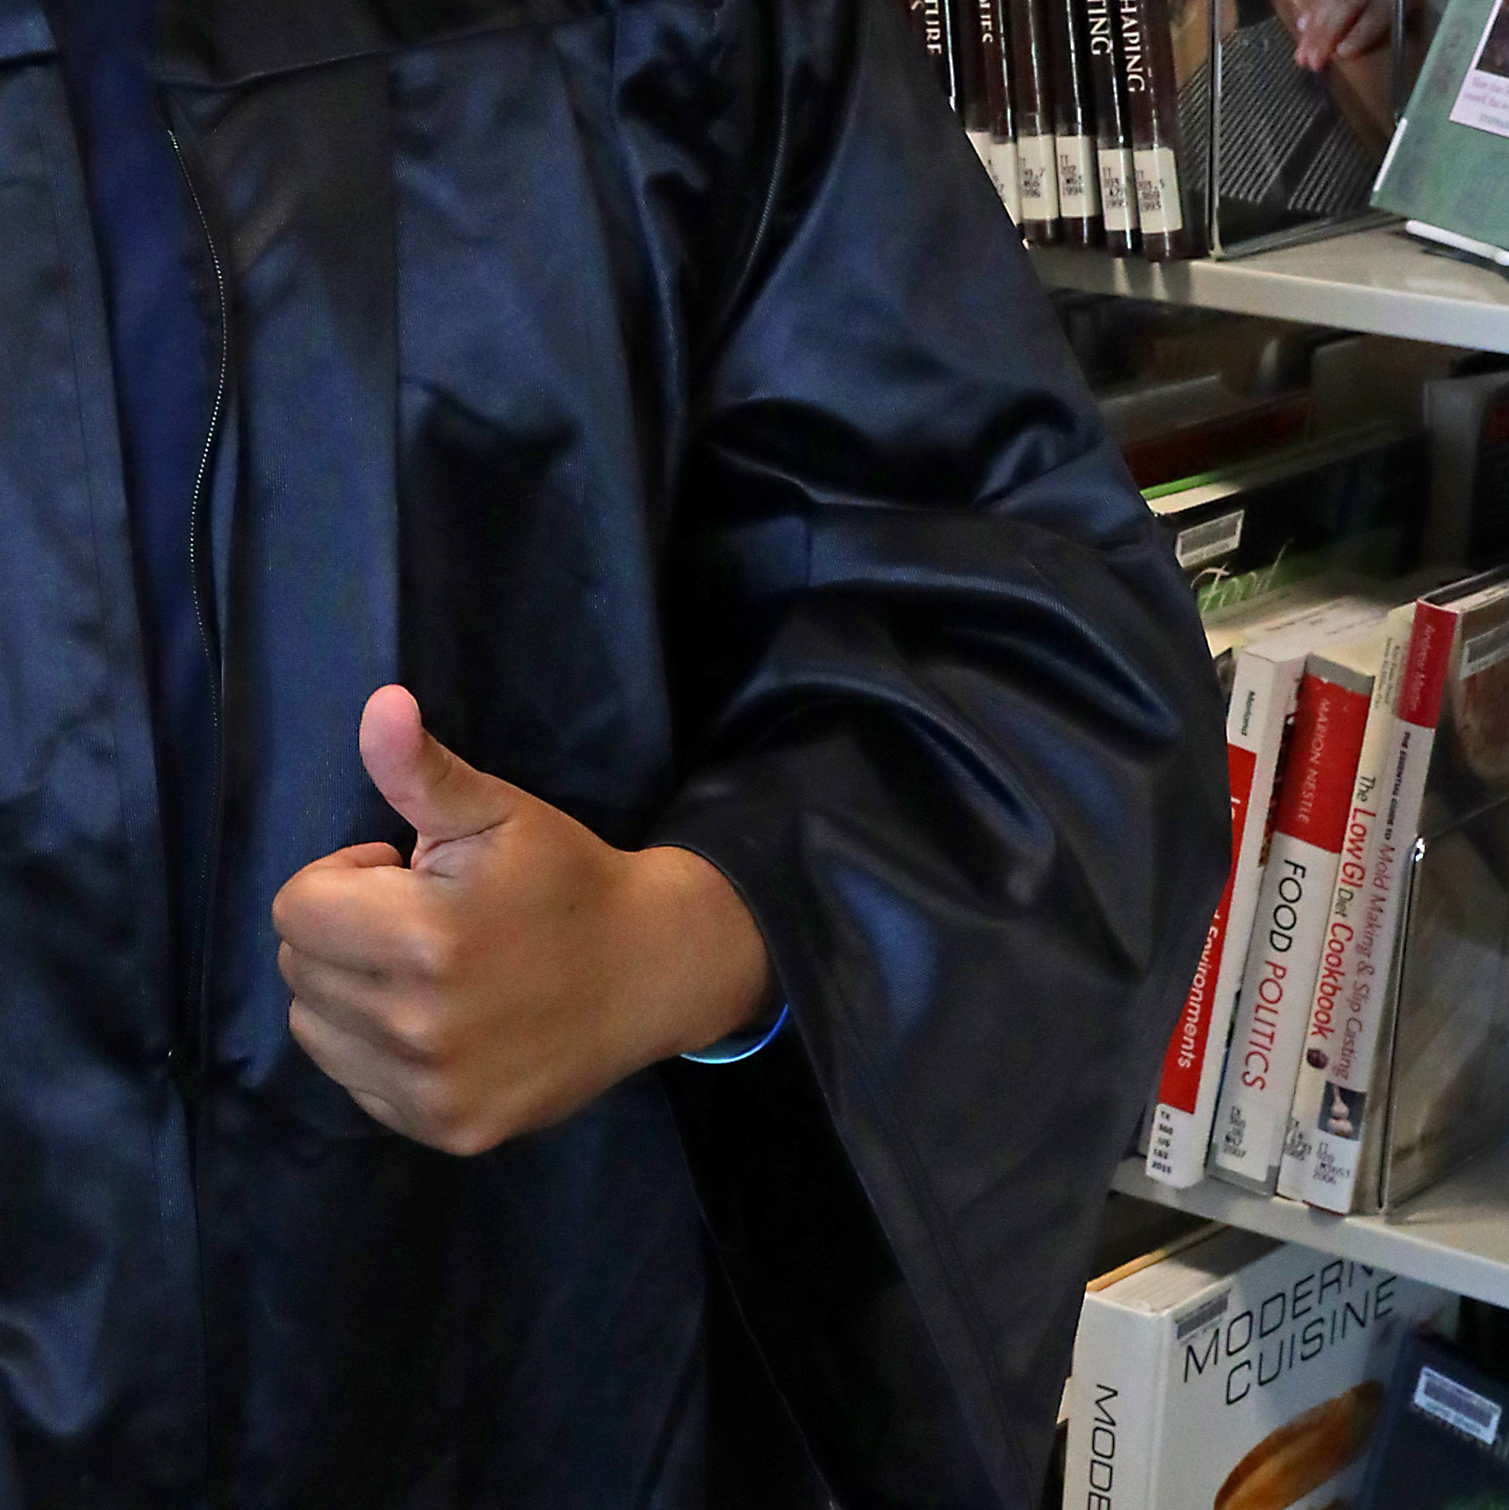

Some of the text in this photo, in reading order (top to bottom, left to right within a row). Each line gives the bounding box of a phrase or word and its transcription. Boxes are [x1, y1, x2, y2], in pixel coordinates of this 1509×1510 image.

[1356, 776, 1377, 802] The
[1345, 807, 1377, 861] Low
[1242, 697, 1331, 1091] MARION NESTLE FOOD POLITICS
[1334, 888, 1354, 916] Diet
[1372, 846, 1397, 894] Mold
[1355, 893, 1386, 958] Making
[1177, 926, 1220, 1070] Environments
[1310, 922, 1354, 1041] Cookbook
[1351, 979, 1372, 1014] Slip
[1357, 963, 1375, 976] &
[1331, 1016, 1363, 1080] Casting
[1184, 1259, 1374, 1383] MODERN
[1226, 1275, 1399, 1406] CUISINE
